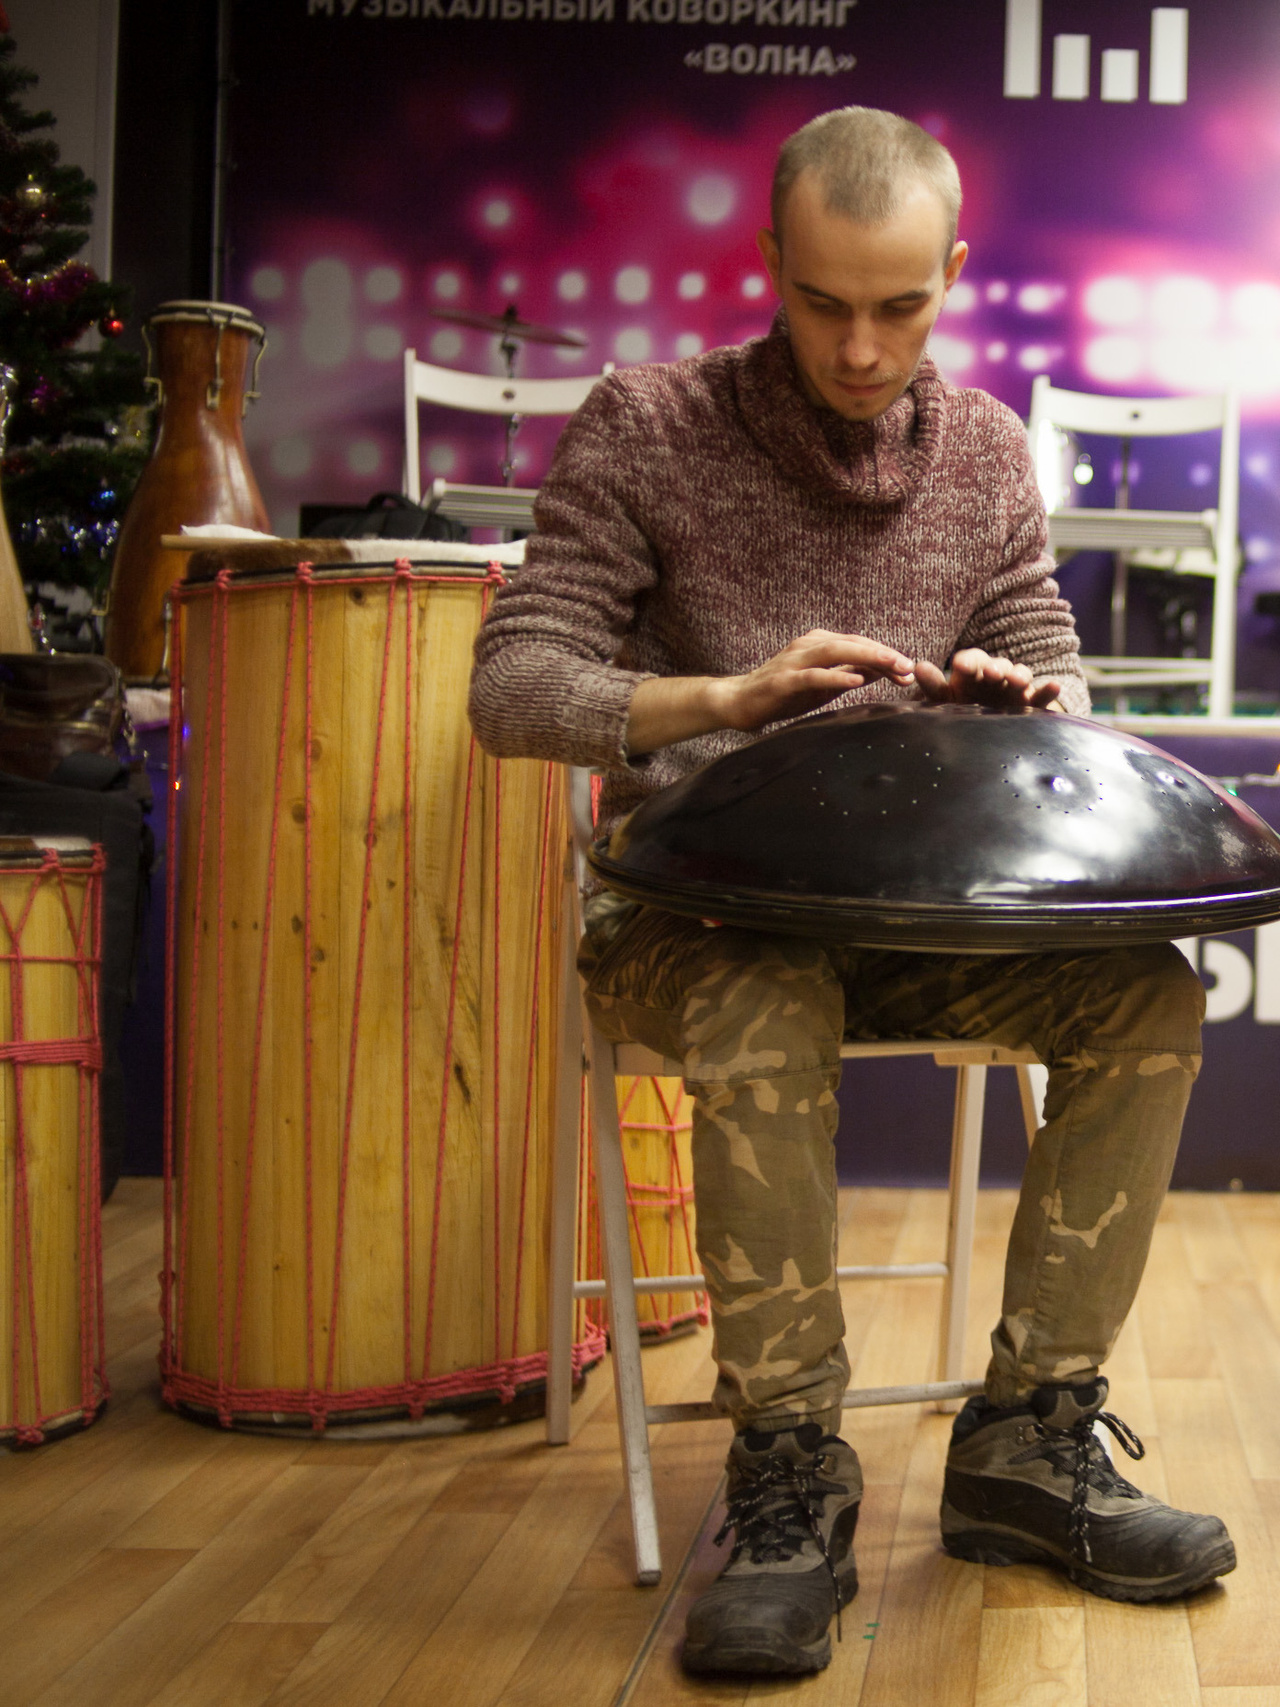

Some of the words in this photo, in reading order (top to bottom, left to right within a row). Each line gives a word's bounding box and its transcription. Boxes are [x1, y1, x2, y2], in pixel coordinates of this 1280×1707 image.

[306, 0, 615, 21] МУЗЫКАЛЬНЫЙ
[626, 0, 856, 27] КОВОРКИНГ
[684, 43, 857, 76] «ВОЛНА»
